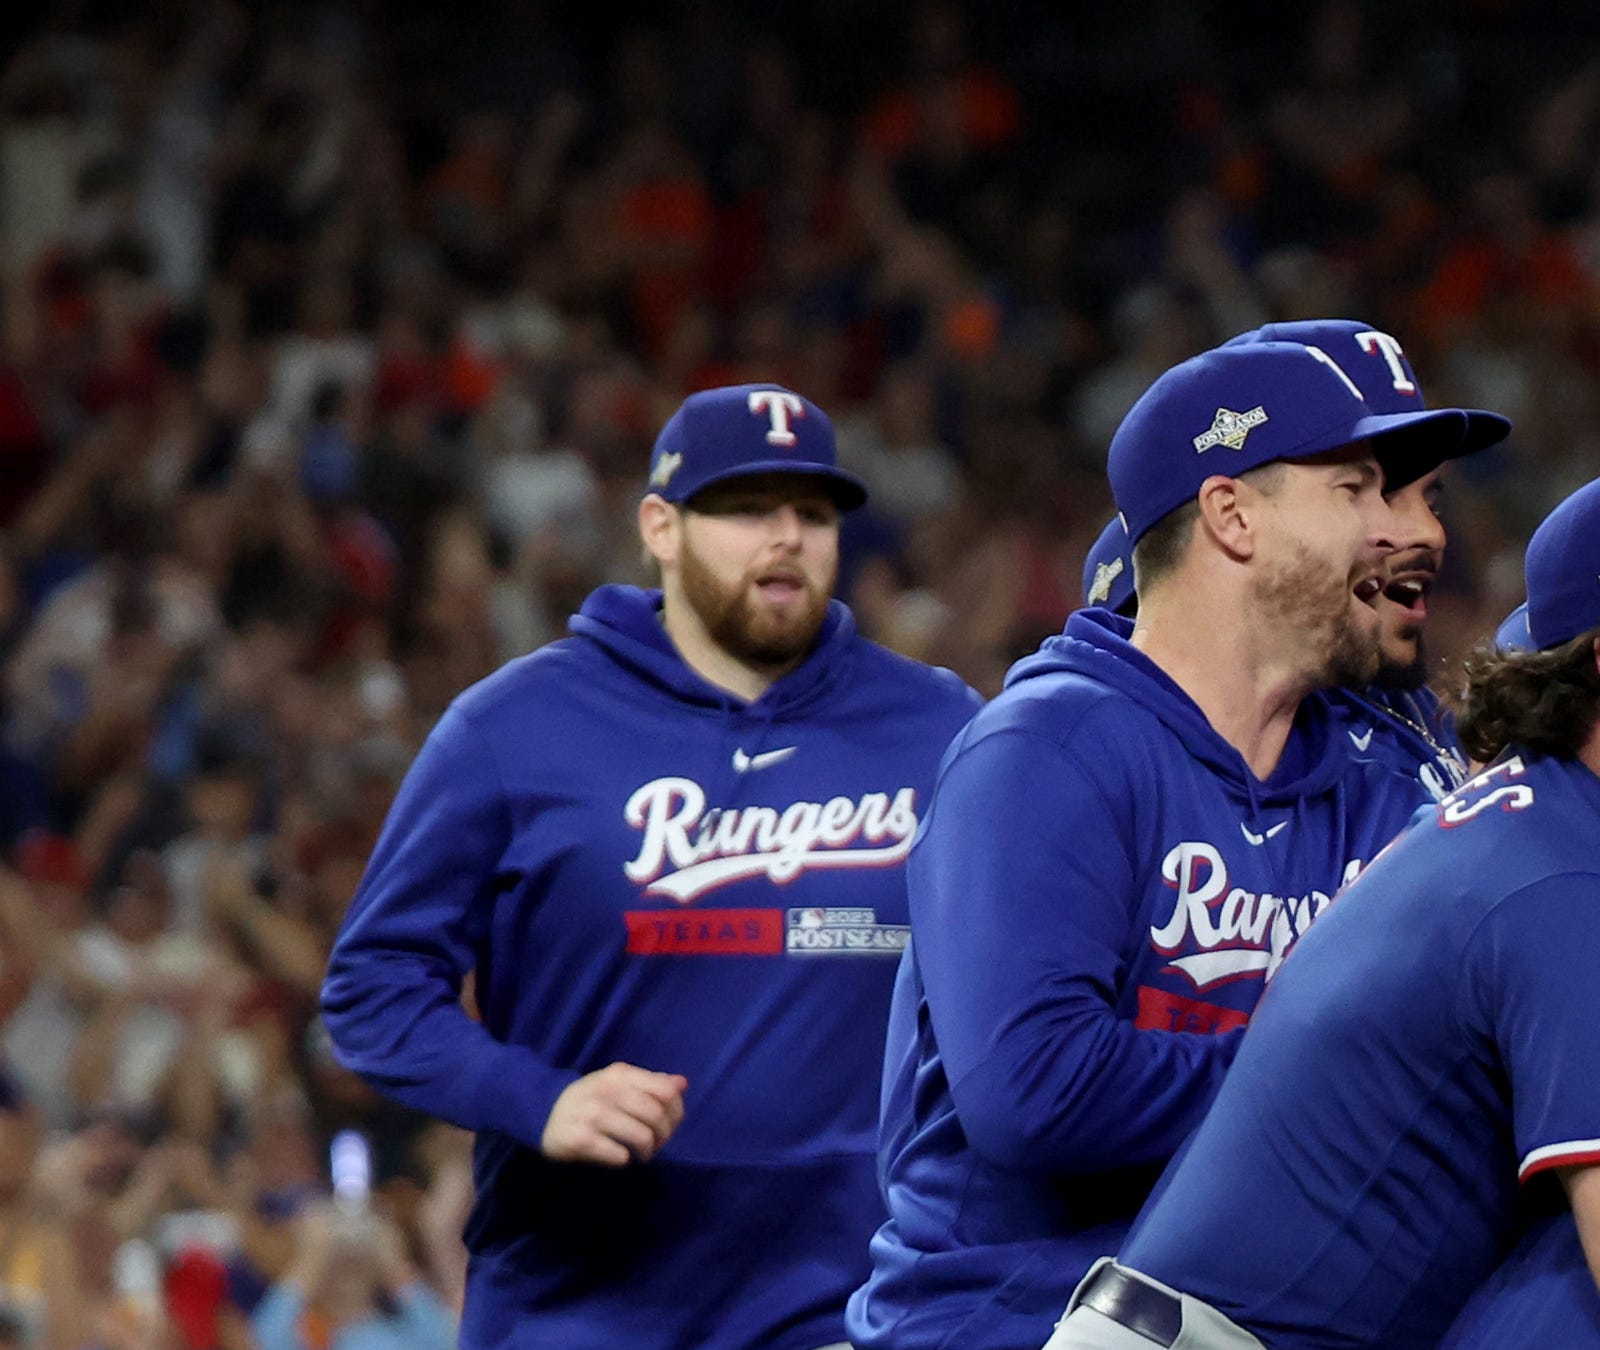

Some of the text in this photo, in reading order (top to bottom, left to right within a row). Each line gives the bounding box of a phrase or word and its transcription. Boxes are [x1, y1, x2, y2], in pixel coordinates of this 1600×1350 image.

[1354, 331, 1416, 396] T
[748, 391, 806, 446] T
[623, 776, 918, 903] Rangers
[653, 920, 762, 941] TEXAS
